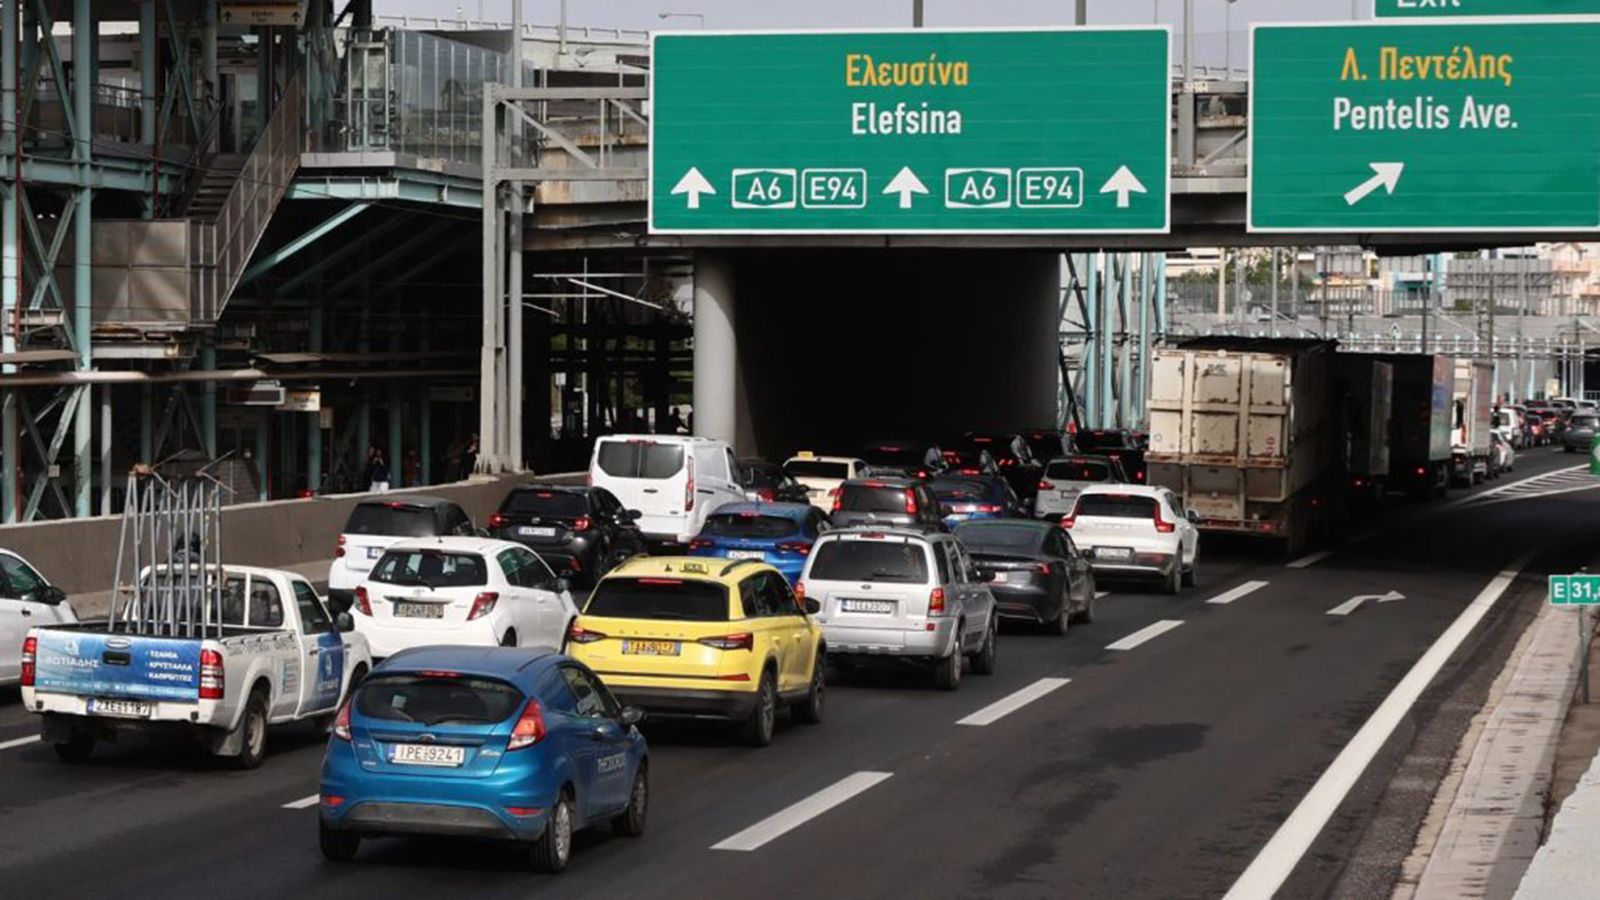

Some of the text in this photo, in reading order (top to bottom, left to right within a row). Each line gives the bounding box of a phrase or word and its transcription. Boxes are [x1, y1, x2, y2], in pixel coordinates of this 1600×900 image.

[846, 53, 969, 87] Ελευσίνα
[1340, 45, 1513, 87] Λ. Πεντέλης
[852, 102, 962, 134] Elefsina
[1333, 95, 1518, 130] Pentelis Ave.
[747, 176, 857, 201] A6 E94
[961, 176, 1074, 200] A6 E94
[1553, 581, 1600, 602] E 31,
